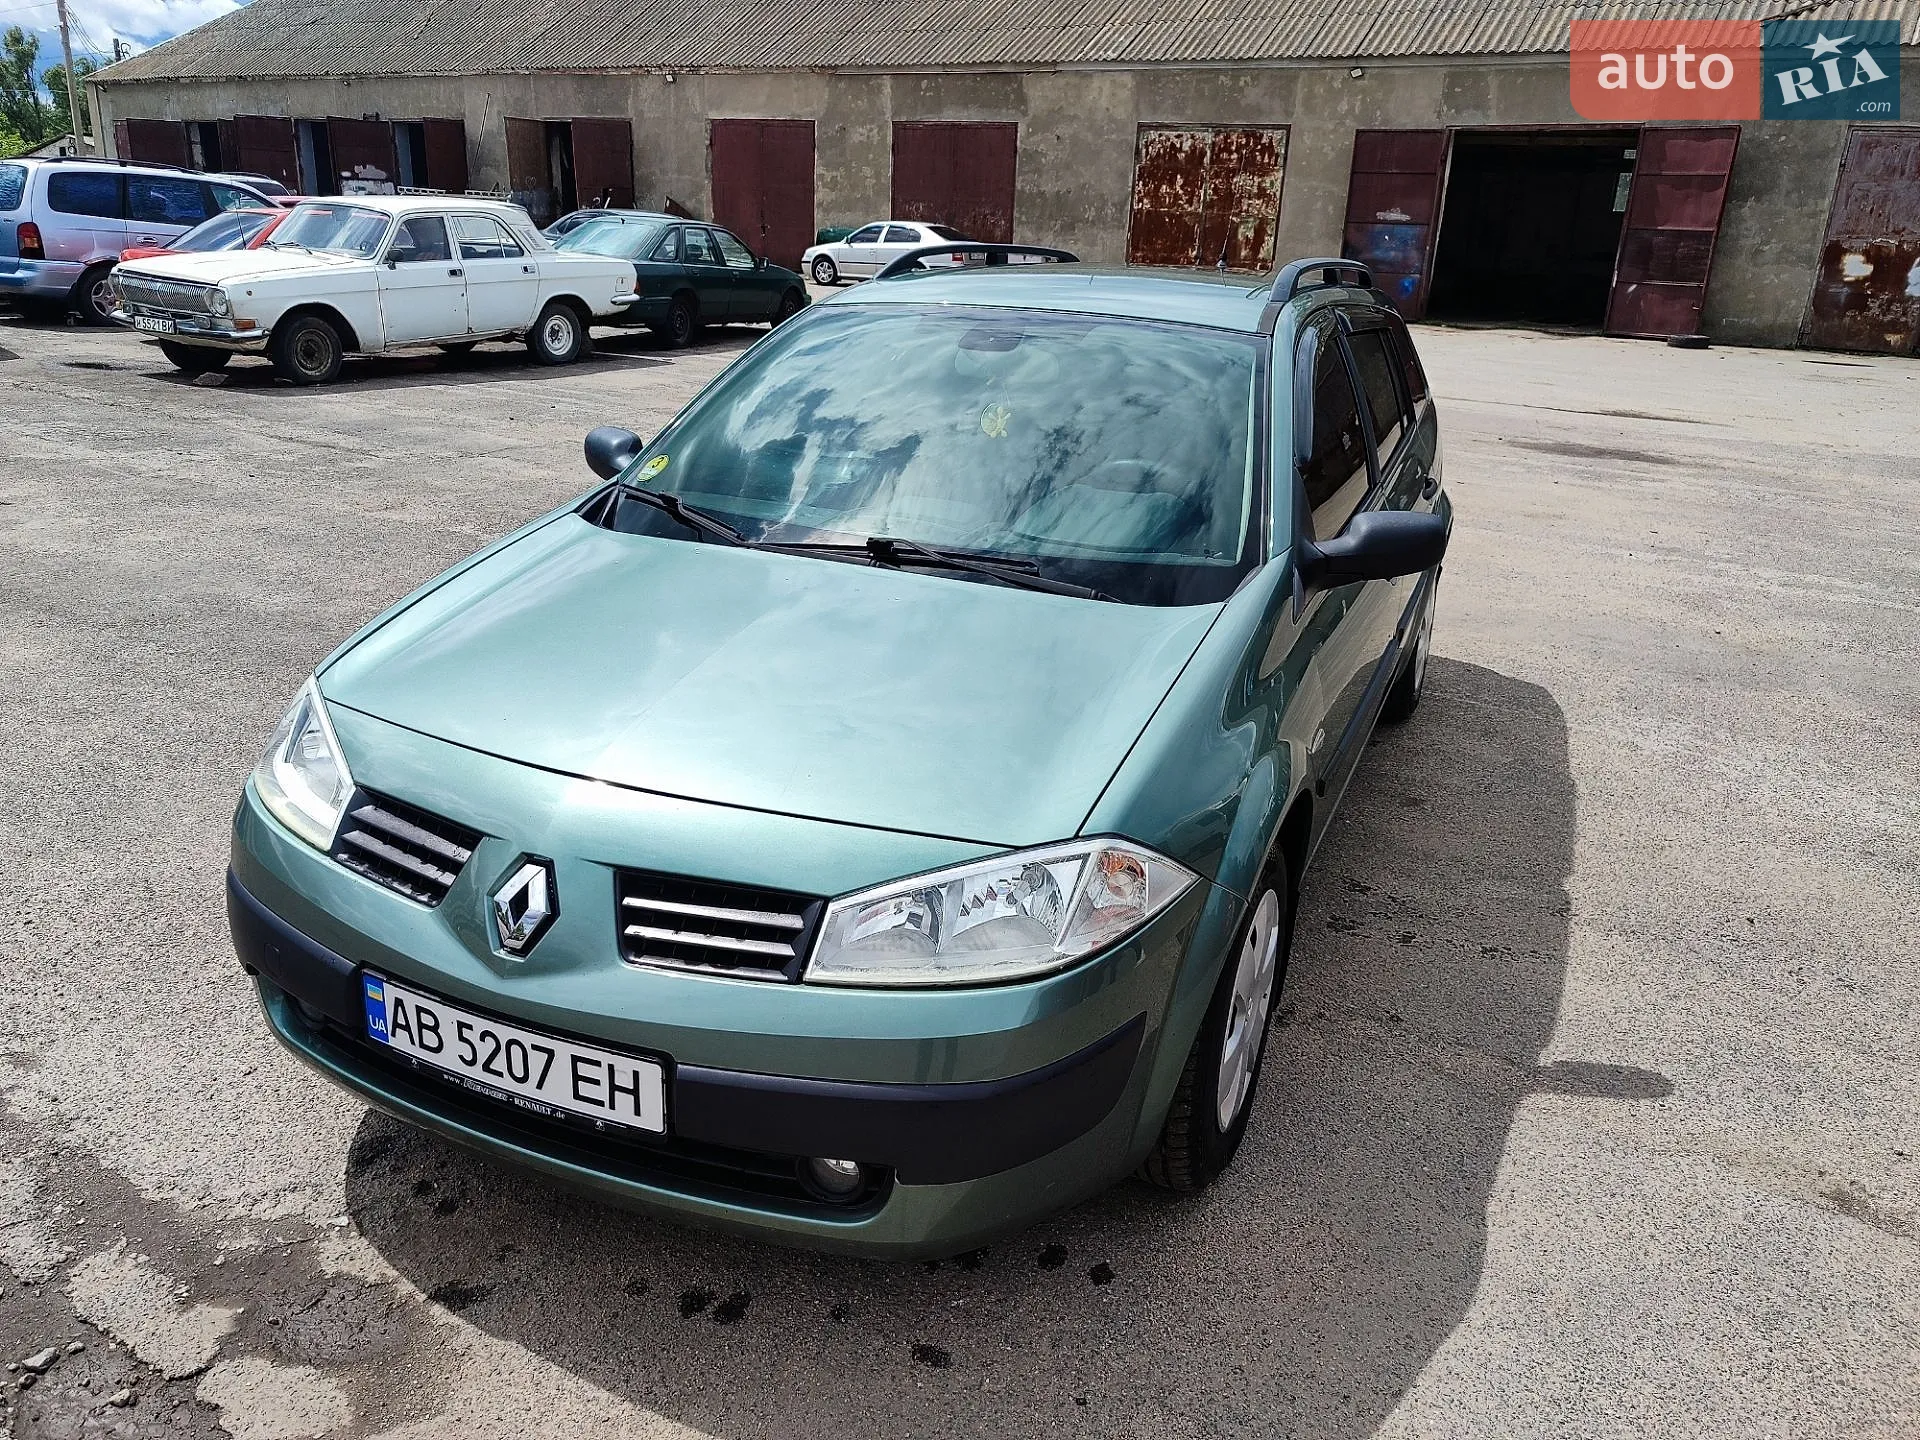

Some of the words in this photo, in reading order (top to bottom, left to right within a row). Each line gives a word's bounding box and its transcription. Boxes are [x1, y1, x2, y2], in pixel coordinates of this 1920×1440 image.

[369, 1014, 387, 1034] UA
[390, 996, 444, 1054] AB
[456, 1019, 557, 1092] 5207
[570, 1053, 642, 1118] EH
